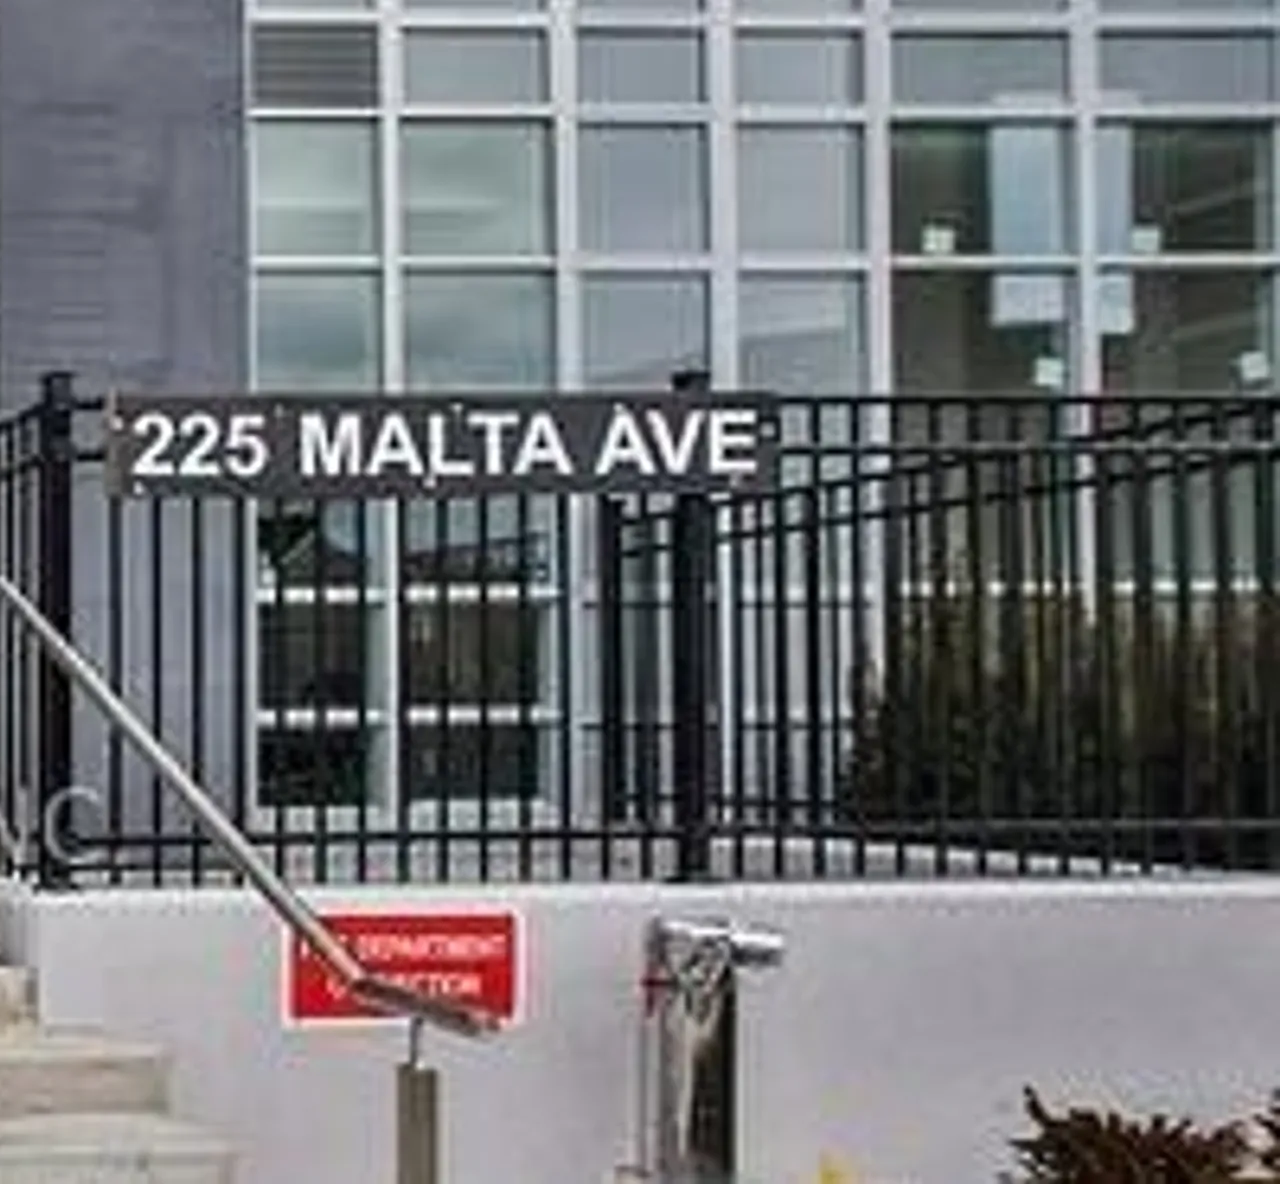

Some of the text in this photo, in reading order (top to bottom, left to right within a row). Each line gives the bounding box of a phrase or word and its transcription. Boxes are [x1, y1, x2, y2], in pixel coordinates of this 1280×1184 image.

[131, 411, 758, 477] 225 MALTA AVE
